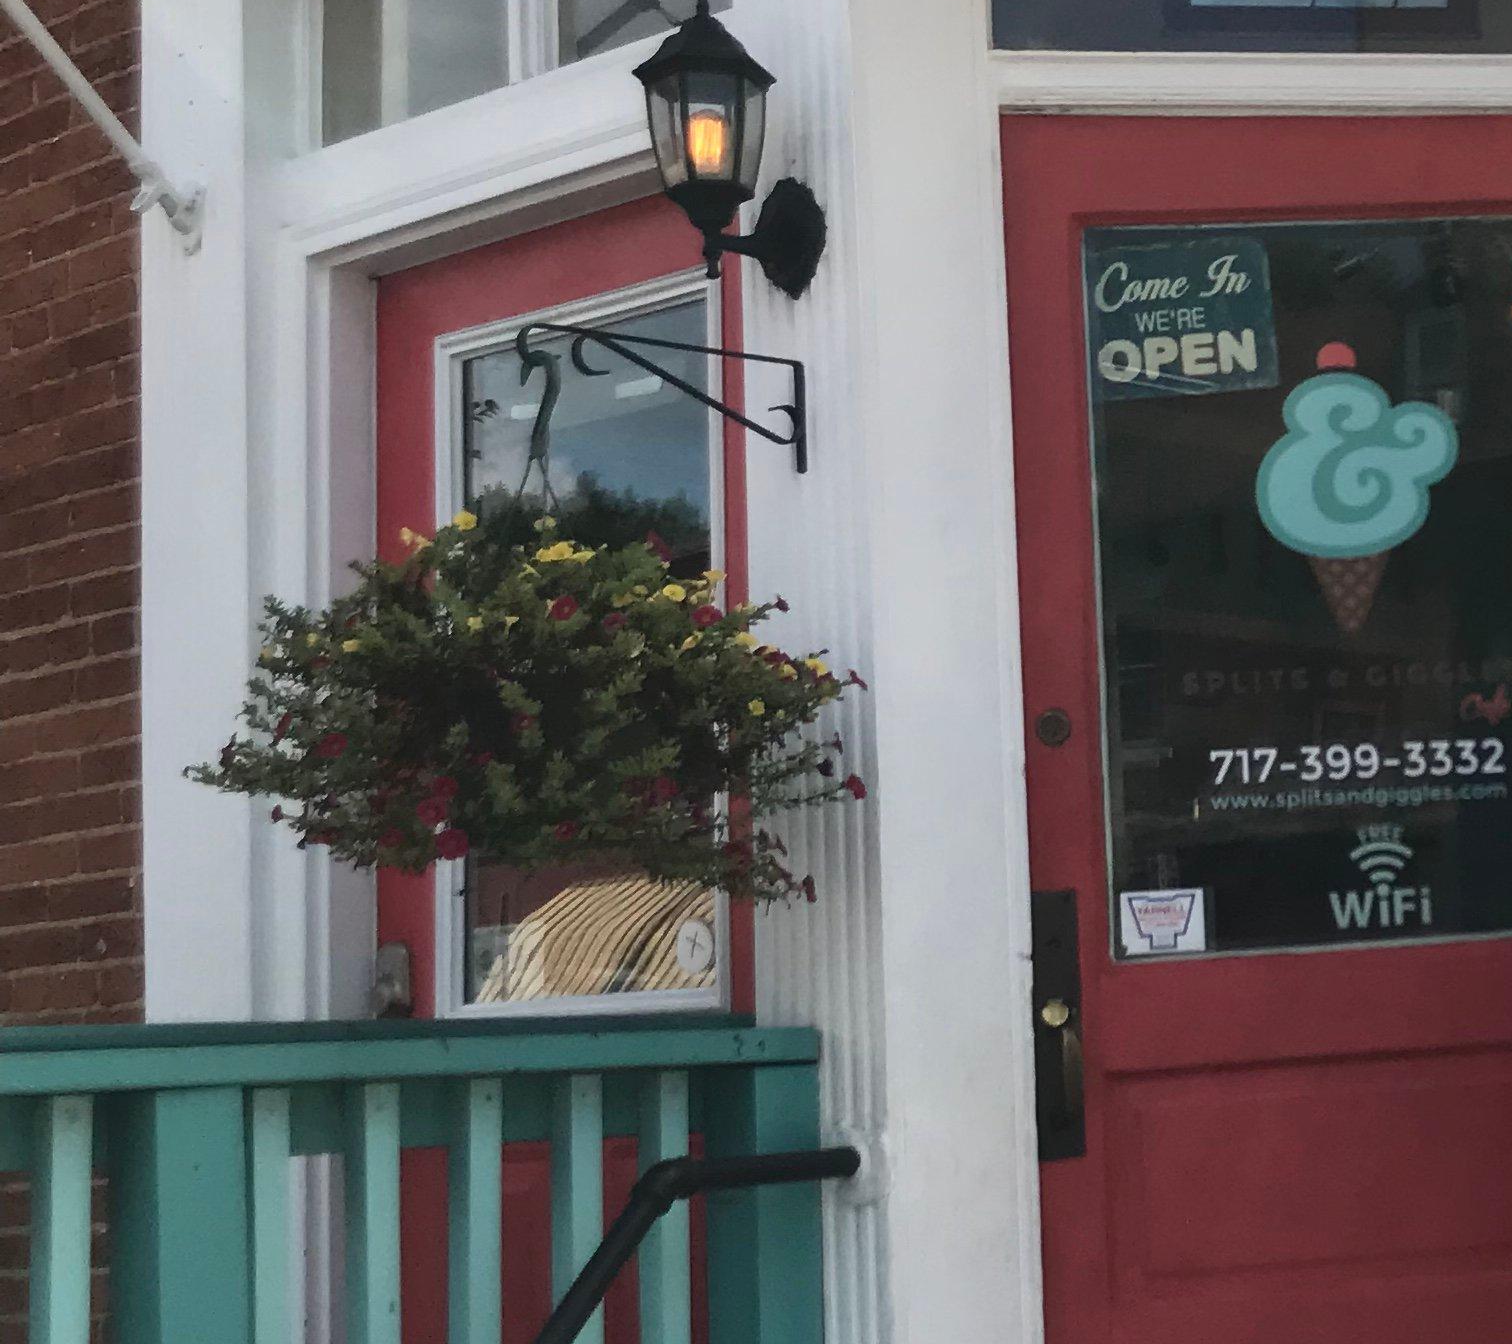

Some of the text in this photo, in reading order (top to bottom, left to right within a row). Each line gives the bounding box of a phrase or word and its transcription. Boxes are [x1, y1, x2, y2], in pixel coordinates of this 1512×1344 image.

[1094, 254, 1252, 314] Come In
[1134, 306, 1207, 333] WE'RE
[1097, 327, 1258, 384] OPEN
[1209, 736, 1507, 787] 717-399-3332
[1210, 781, 1508, 812] www.splitsandgiggles.com
[1328, 882, 1433, 931] WiFi
